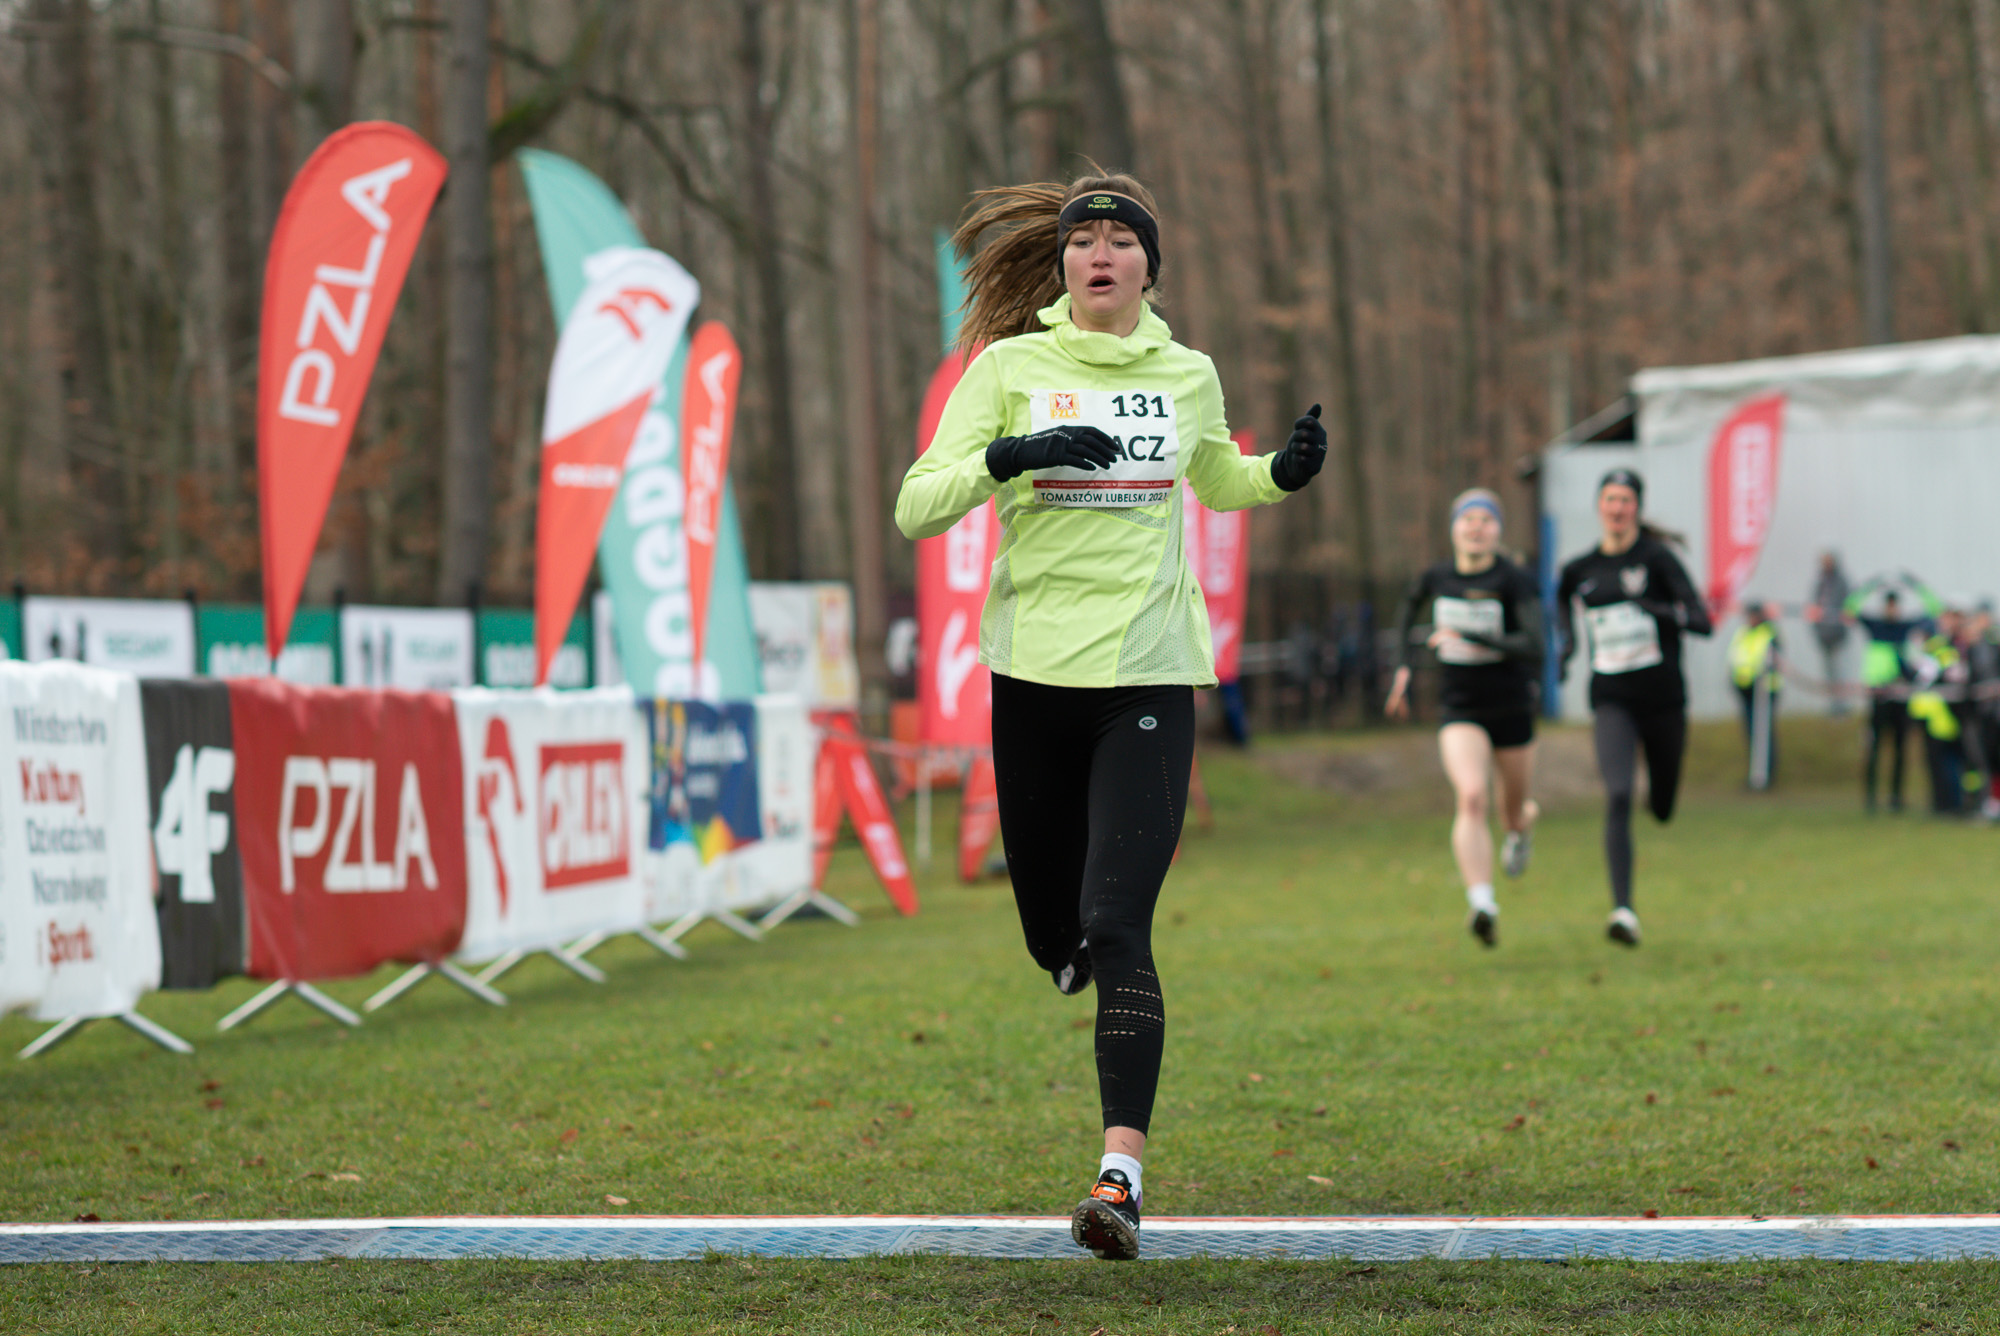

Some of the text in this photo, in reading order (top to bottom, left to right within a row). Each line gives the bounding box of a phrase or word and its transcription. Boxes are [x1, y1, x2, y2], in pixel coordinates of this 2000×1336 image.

[279, 157, 412, 427] PZLA
[685, 350, 732, 546] PZLA
[1112, 394, 1168, 418] 131
[1113, 435, 1165, 461] ACZ
[1041, 491, 1102, 502] TOMASZÓW
[1106, 493, 1146, 502] LUBELSKI
[155, 743, 235, 903] 4F
[279, 756, 438, 894] PZLA
